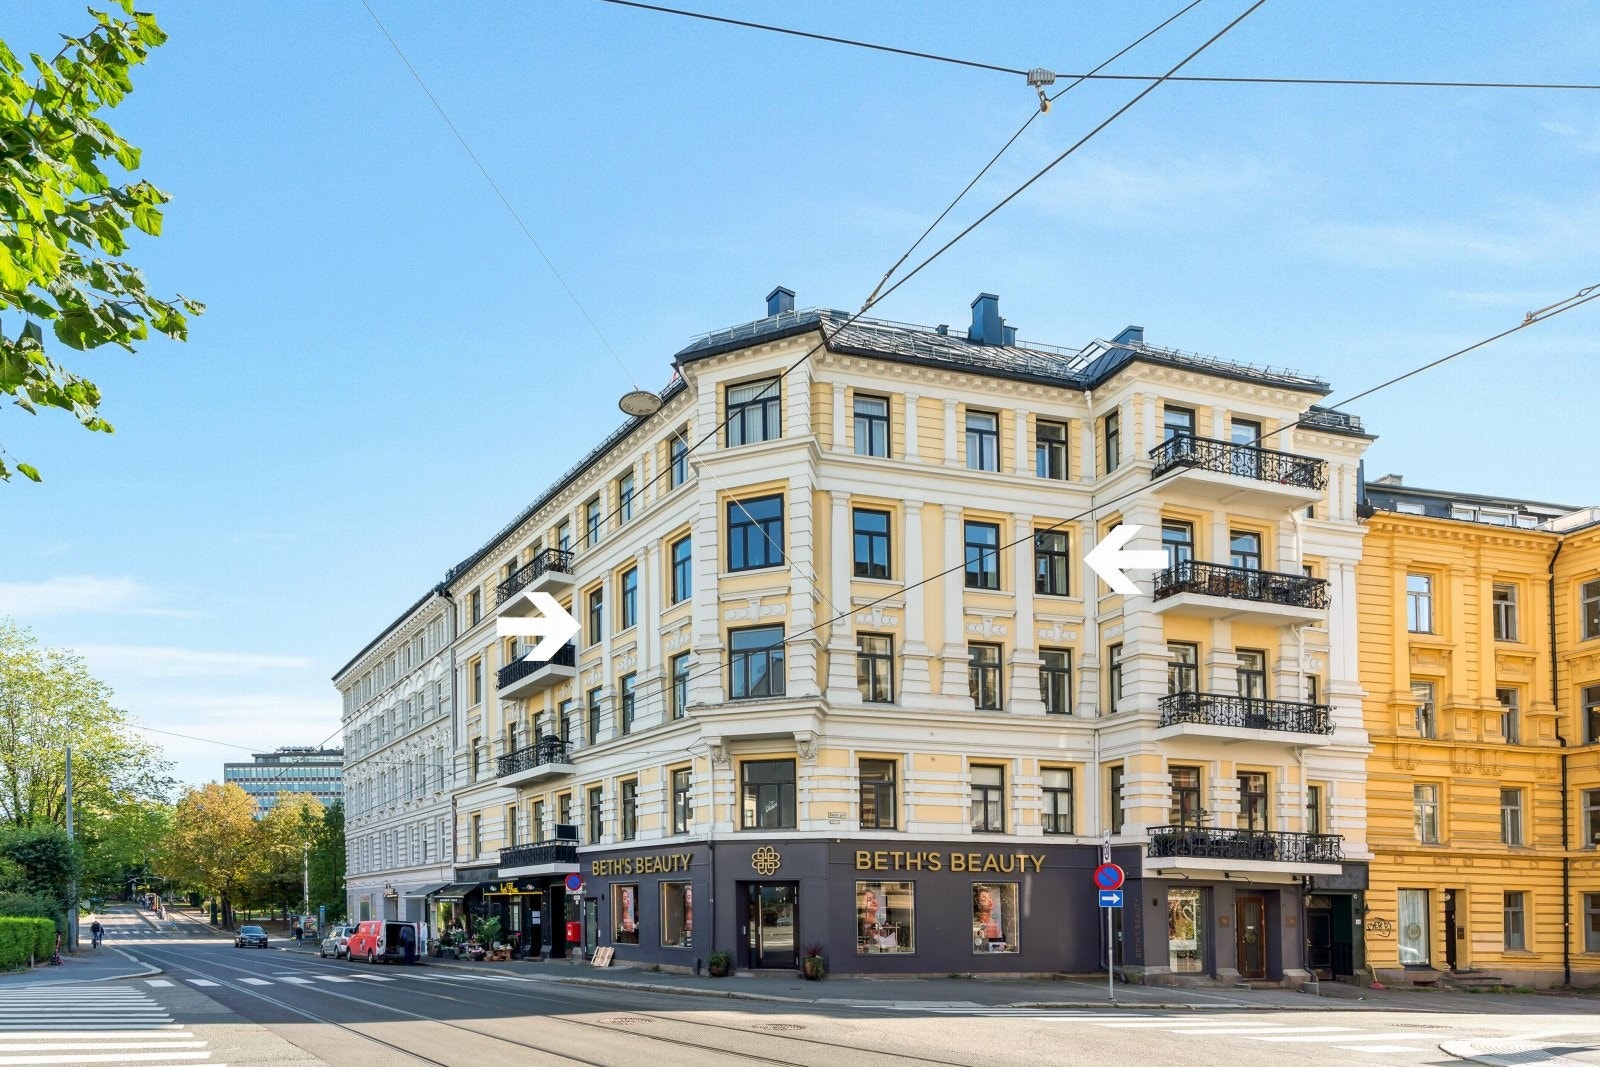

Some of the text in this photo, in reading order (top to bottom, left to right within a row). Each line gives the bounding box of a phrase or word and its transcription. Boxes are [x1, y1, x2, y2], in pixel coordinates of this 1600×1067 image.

[592, 853, 691, 876] BETH'S BEAUTY
[855, 850, 1046, 873] BETH'S BEAUTY
